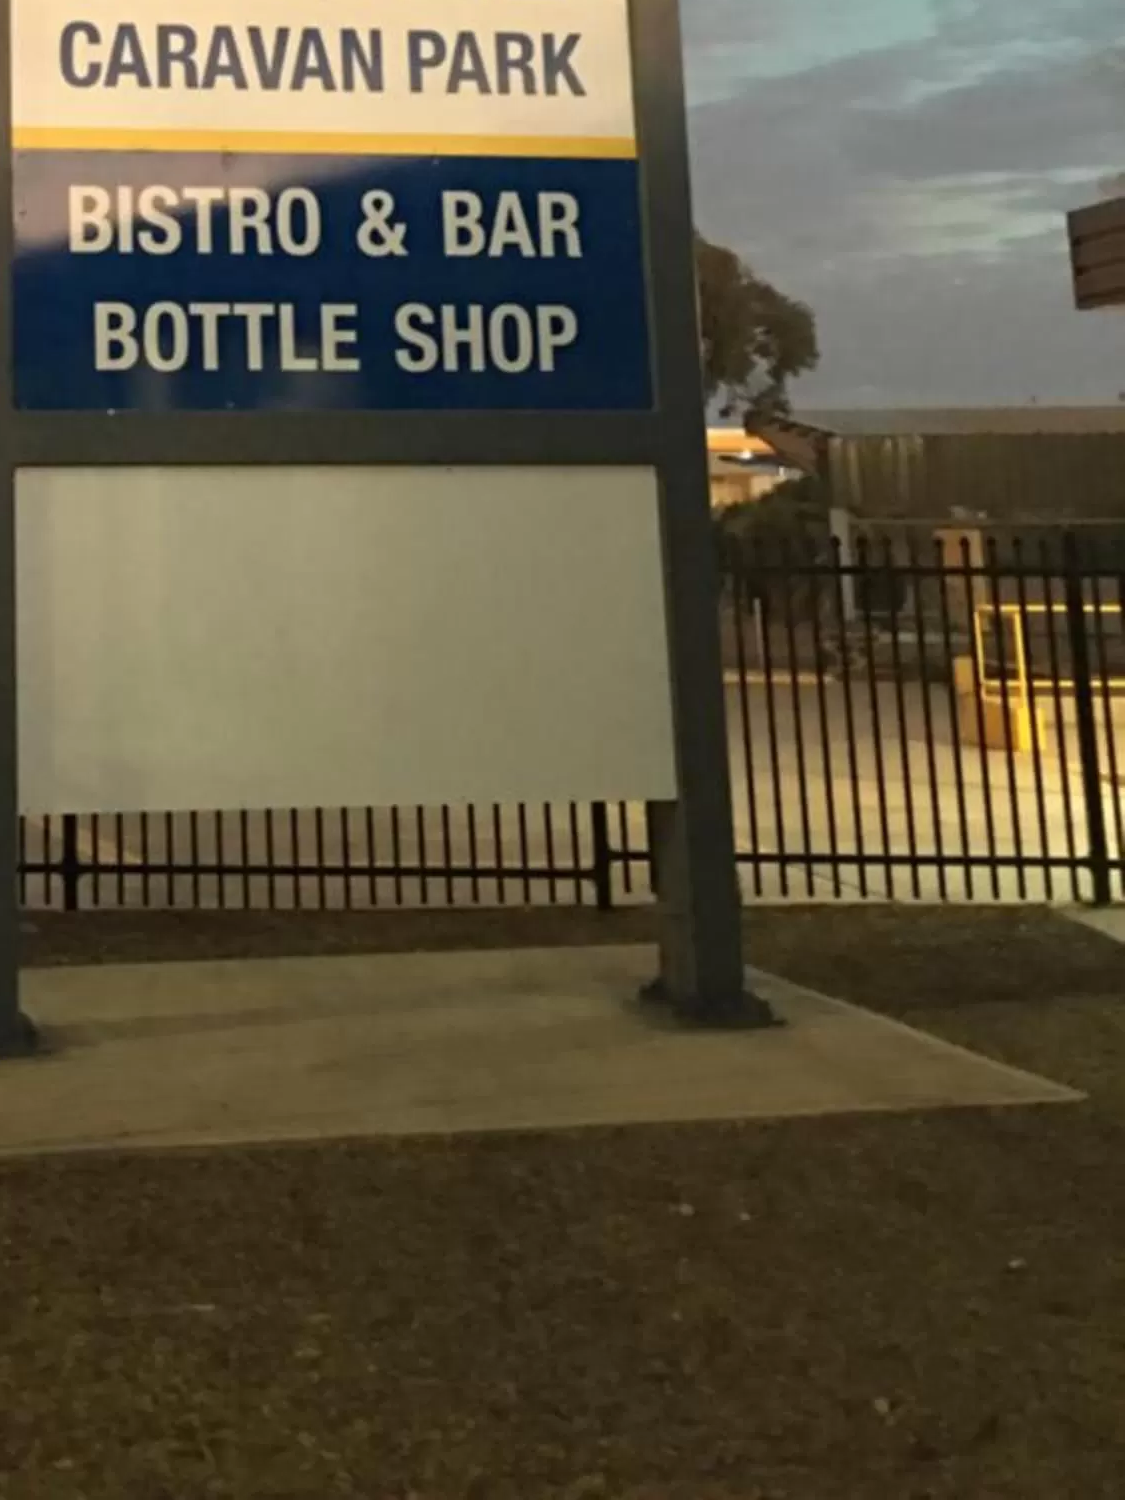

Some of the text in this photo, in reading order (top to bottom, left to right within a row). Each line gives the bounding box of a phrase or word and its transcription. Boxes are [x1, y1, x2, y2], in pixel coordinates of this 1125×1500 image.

[59, 21, 586, 97] CARAVAN PARK
[68, 184, 582, 257] BISTRO & BAR
[94, 302, 578, 373] BOTTLE SHOP
